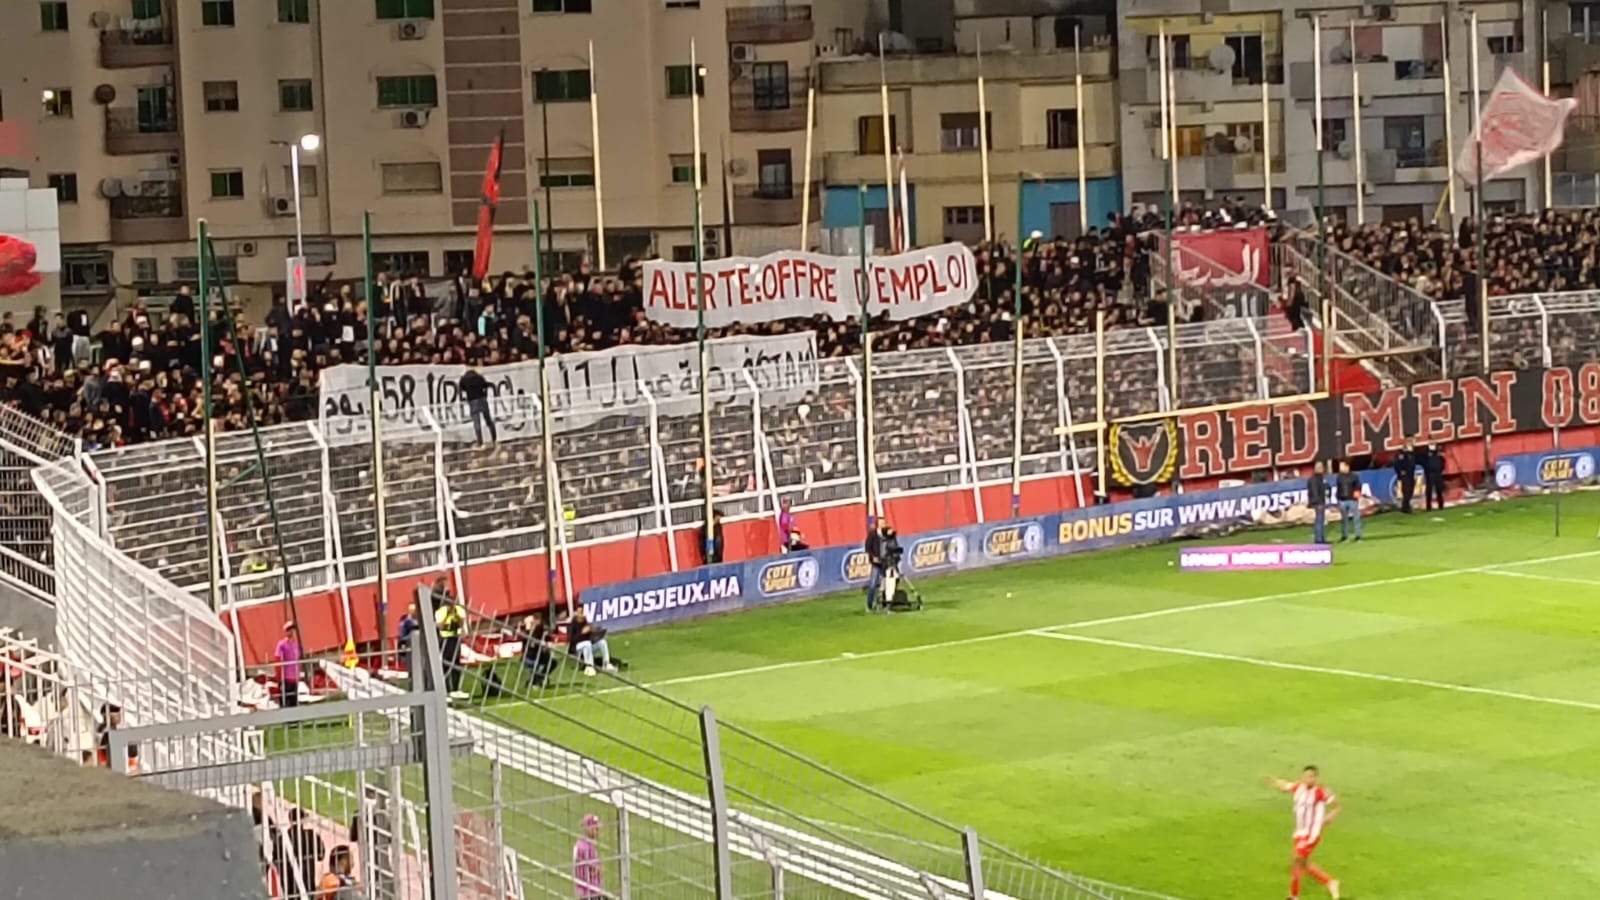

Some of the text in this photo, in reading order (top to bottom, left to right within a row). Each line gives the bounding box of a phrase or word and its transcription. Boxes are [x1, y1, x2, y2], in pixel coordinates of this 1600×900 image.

[854, 253, 968, 306] D'EMPLOI
[1178, 362, 1600, 479] RED MEN 08
[1058, 513, 1132, 545] BONUS
[1133, 507, 1174, 532] SUR
